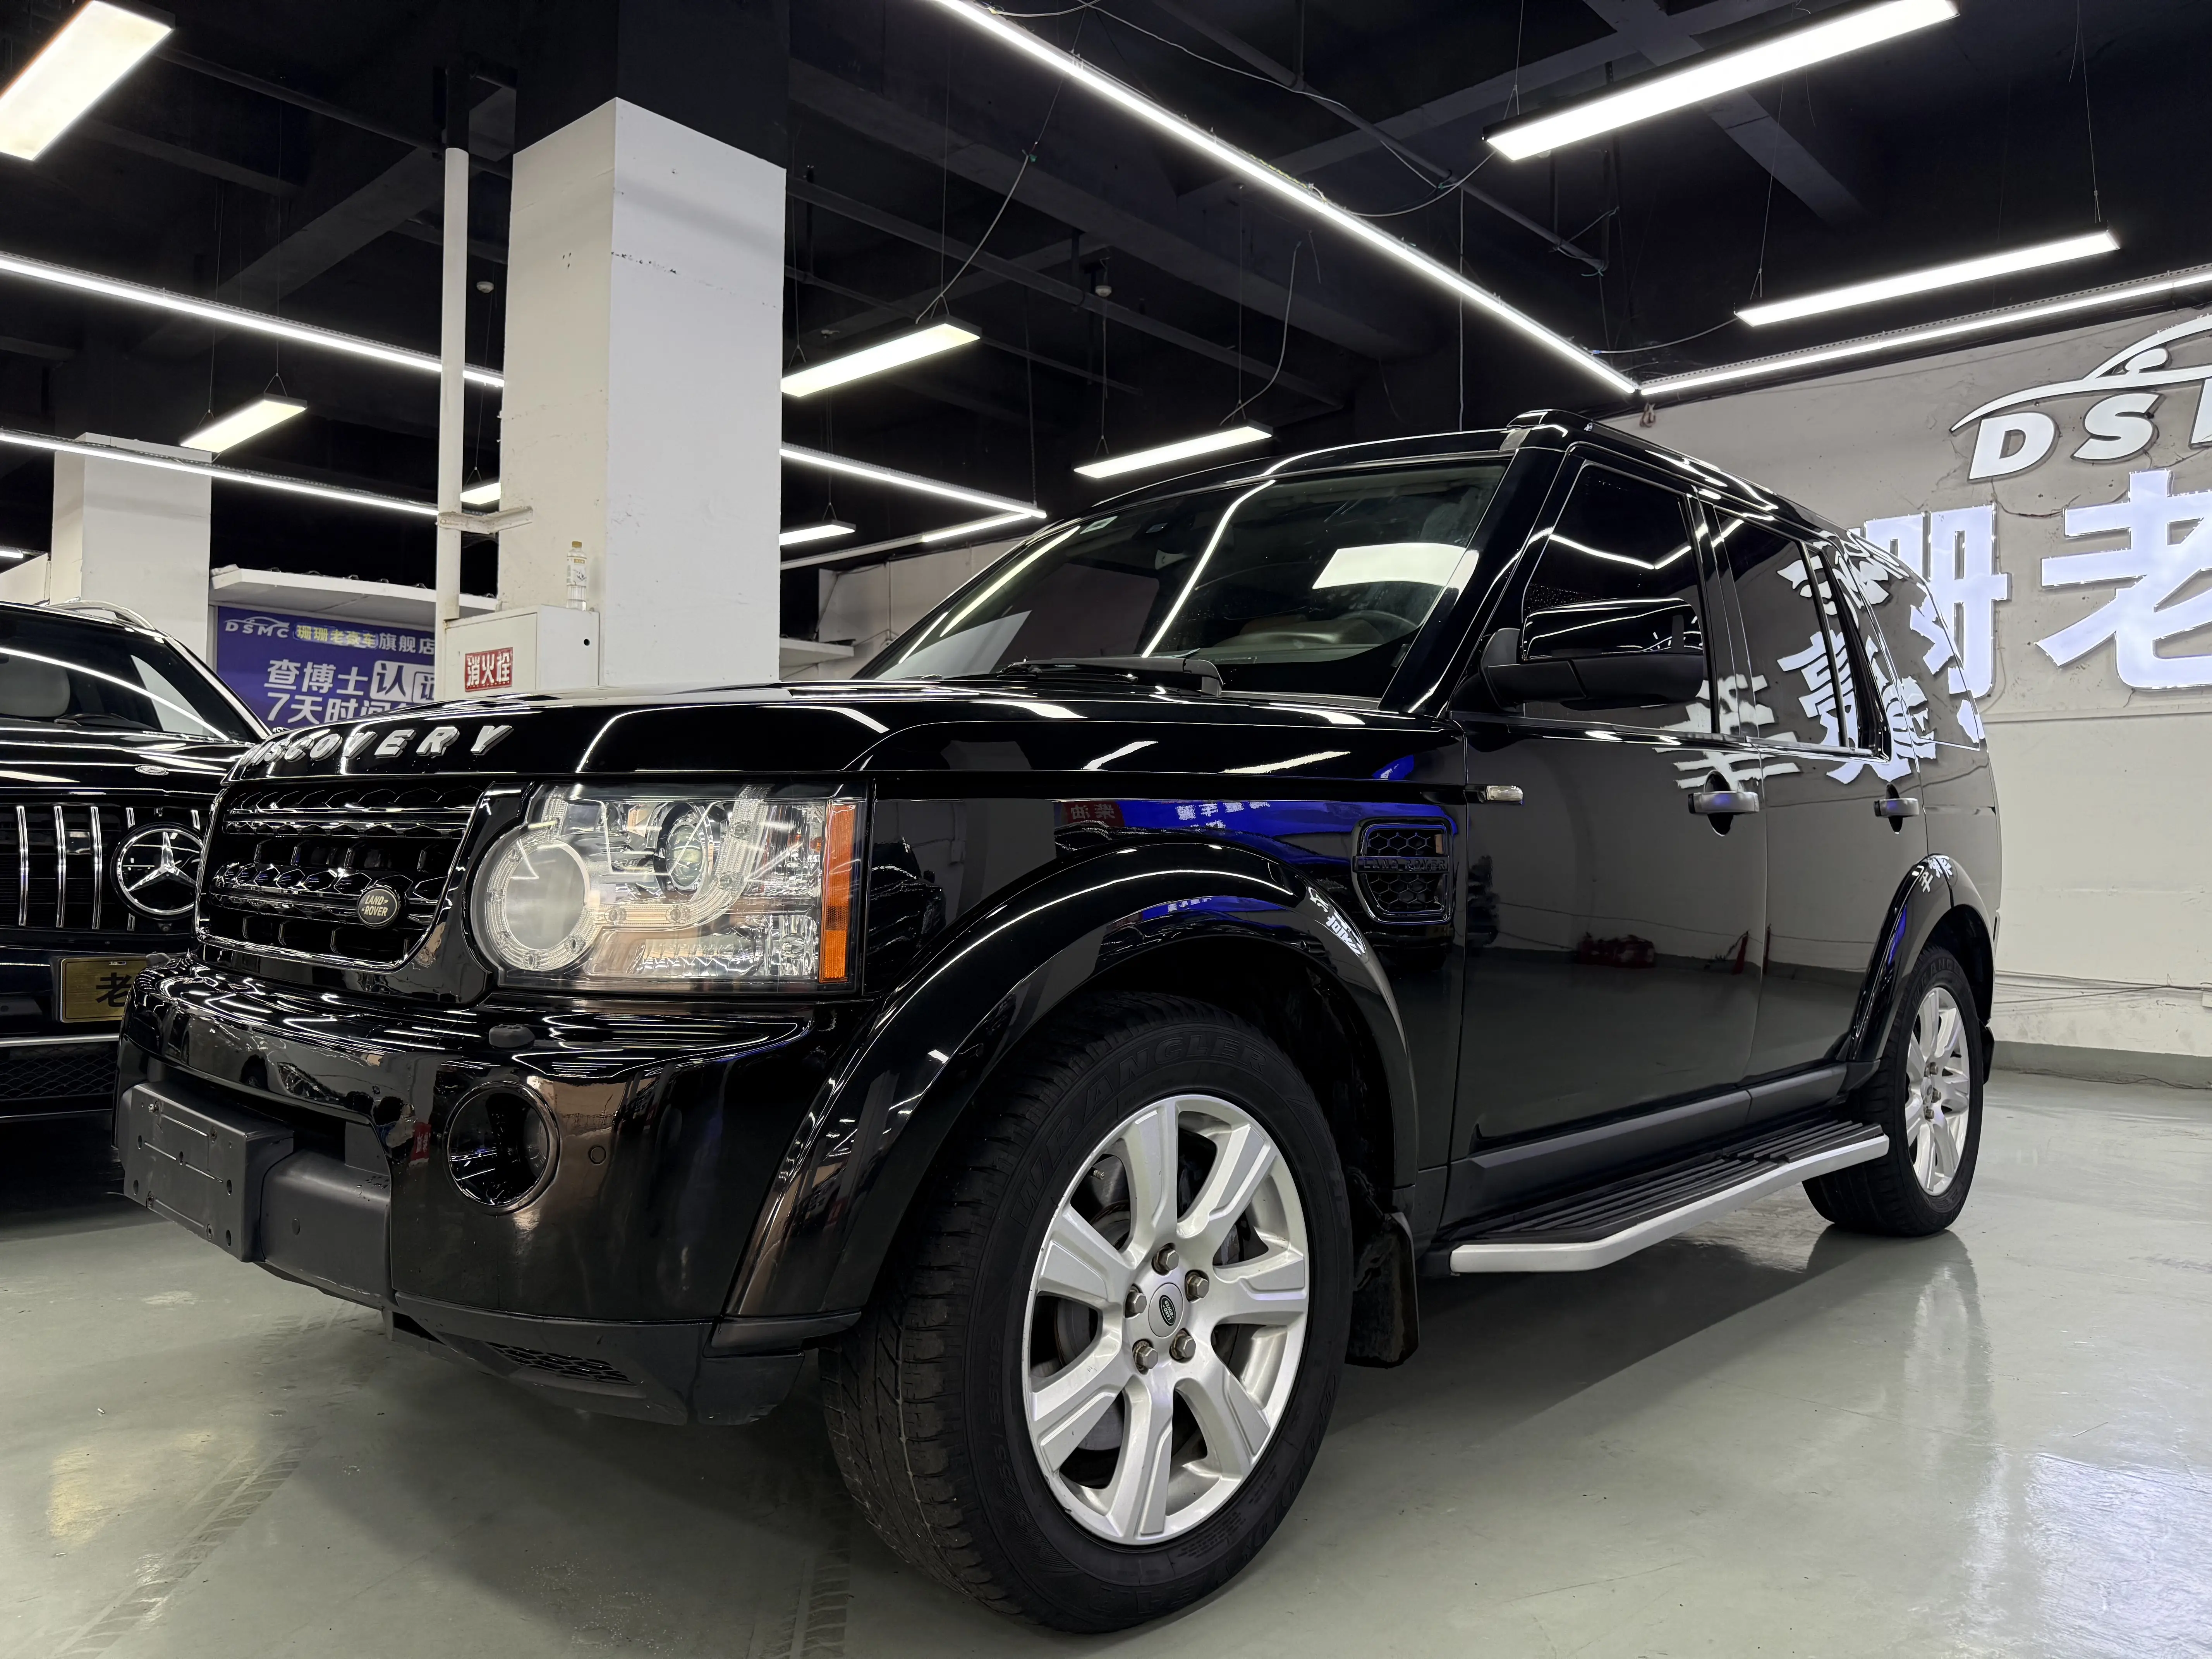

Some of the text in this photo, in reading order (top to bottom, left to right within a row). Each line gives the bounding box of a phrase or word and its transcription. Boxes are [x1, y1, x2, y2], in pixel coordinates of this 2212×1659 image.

[1969, 379, 2212, 480] DS
[225, 622, 290, 638] DSMC
[467, 653, 511, 686] 消火栓
[1363, 858, 1446, 871] LAND ROVER
[364, 895, 385, 905] LAND
[364, 905, 388, 917] ROVER
[95, 972, 132, 1007] 老
[1010, 1034, 1268, 1229] WRANGLER
